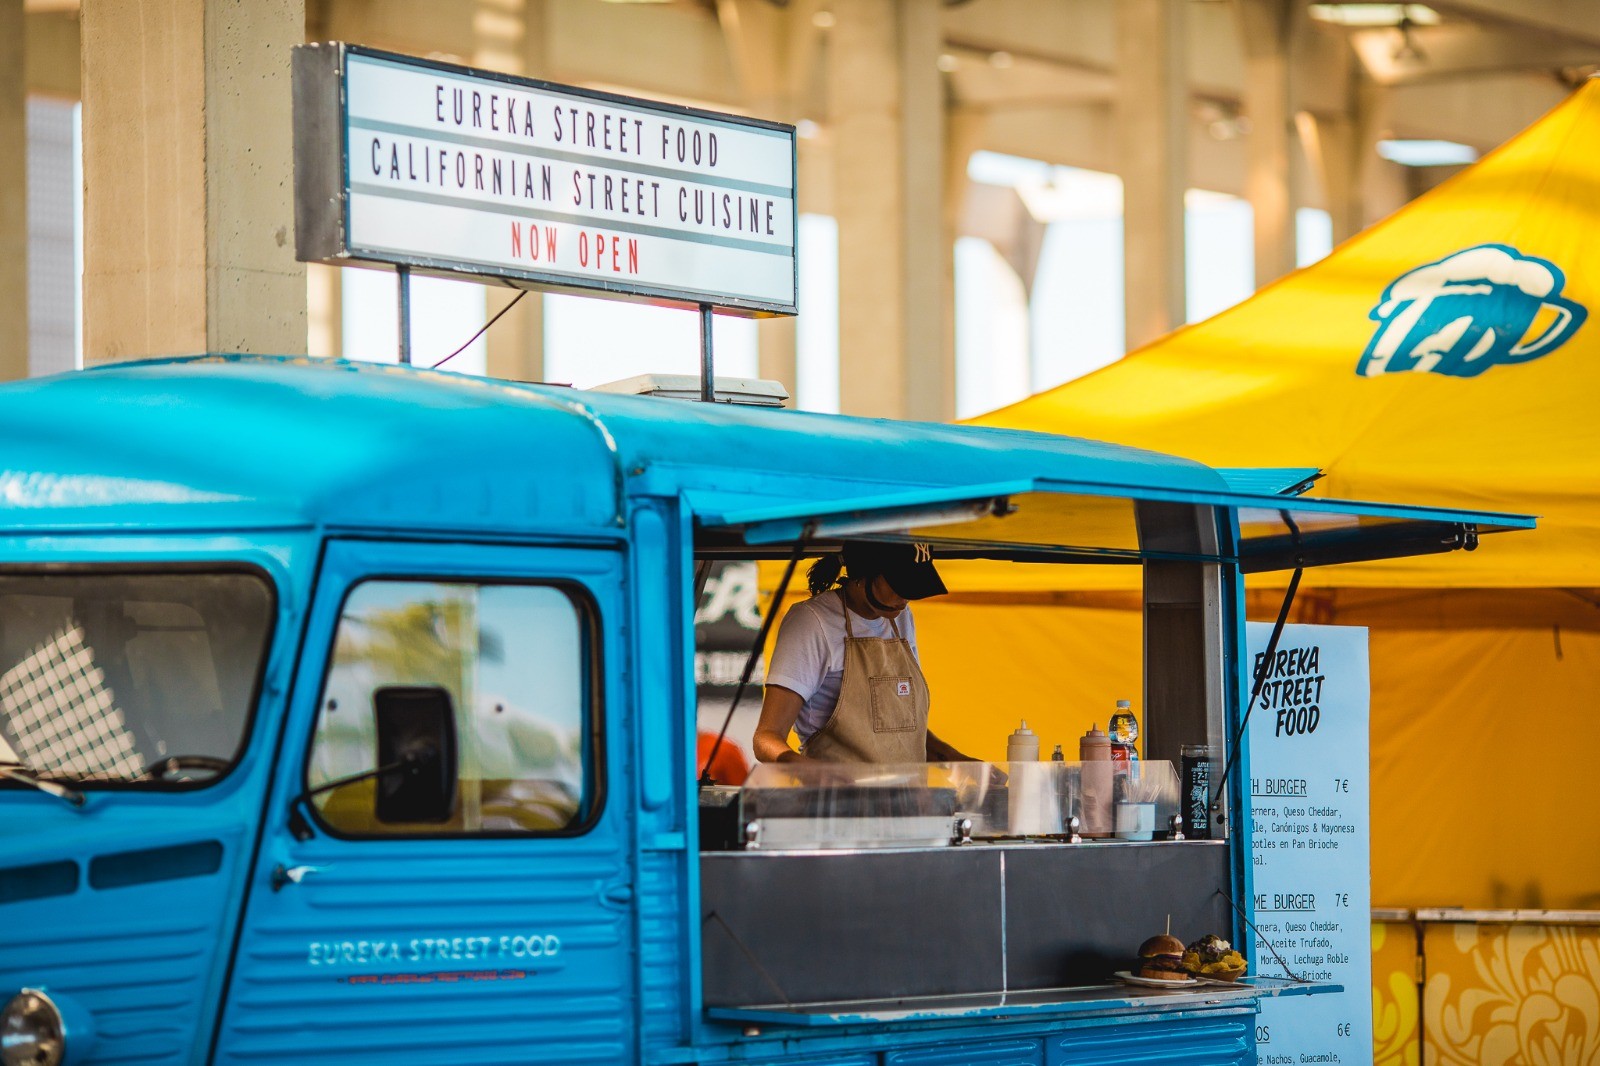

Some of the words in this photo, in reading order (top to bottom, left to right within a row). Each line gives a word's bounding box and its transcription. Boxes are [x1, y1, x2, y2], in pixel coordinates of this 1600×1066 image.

[436, 85, 534, 137] EUREKA
[554, 106, 643, 155] STREET
[662, 125, 718, 168] FOOD
[371, 137, 551, 201] CALIFORNIAN
[573, 170, 661, 218] STREET
[679, 187, 774, 235] CUISINE
[511, 221, 557, 263] NOW
[579, 231, 639, 274] OPEN
[1260, 675, 1325, 710] STREET
[1276, 705, 1320, 737] FOOD
[1266, 779, 1307, 794] BURGER
[1335, 779, 1349, 793] 7€
[1284, 807, 1305, 818] Queso
[1308, 807, 1342, 818] Cheddar,
[1272, 822, 1309, 834] Canónigos
[1313, 823, 1318, 832] &
[1321, 823, 1355, 835] Mayonesa
[1280, 841, 1289, 849] en
[1293, 839, 1305, 849] Pan
[1309, 839, 1339, 849] Brioche
[1274, 894, 1316, 909] BURGER
[1335, 893, 1349, 907] 7€
[1285, 922, 1306, 933] Queso
[1310, 921, 1343, 932] Cheddar,
[308, 941, 400, 965] EUREKA
[410, 937, 491, 961] STREET
[500, 935, 560, 957] FOOD
[1271, 938, 1296, 948] Aceite
[1300, 938, 1333, 949] Trufado,
[1294, 954, 1323, 966] Lechuga
[1327, 953, 1349, 964] Roble
[1303, 970, 1332, 980] Brioche
[1255, 1026, 1270, 1041] OS
[1337, 1023, 1351, 1037] 6€
[1267, 1054, 1296, 1065] Nachos,
[1300, 1052, 1341, 1064] Guacamole,
